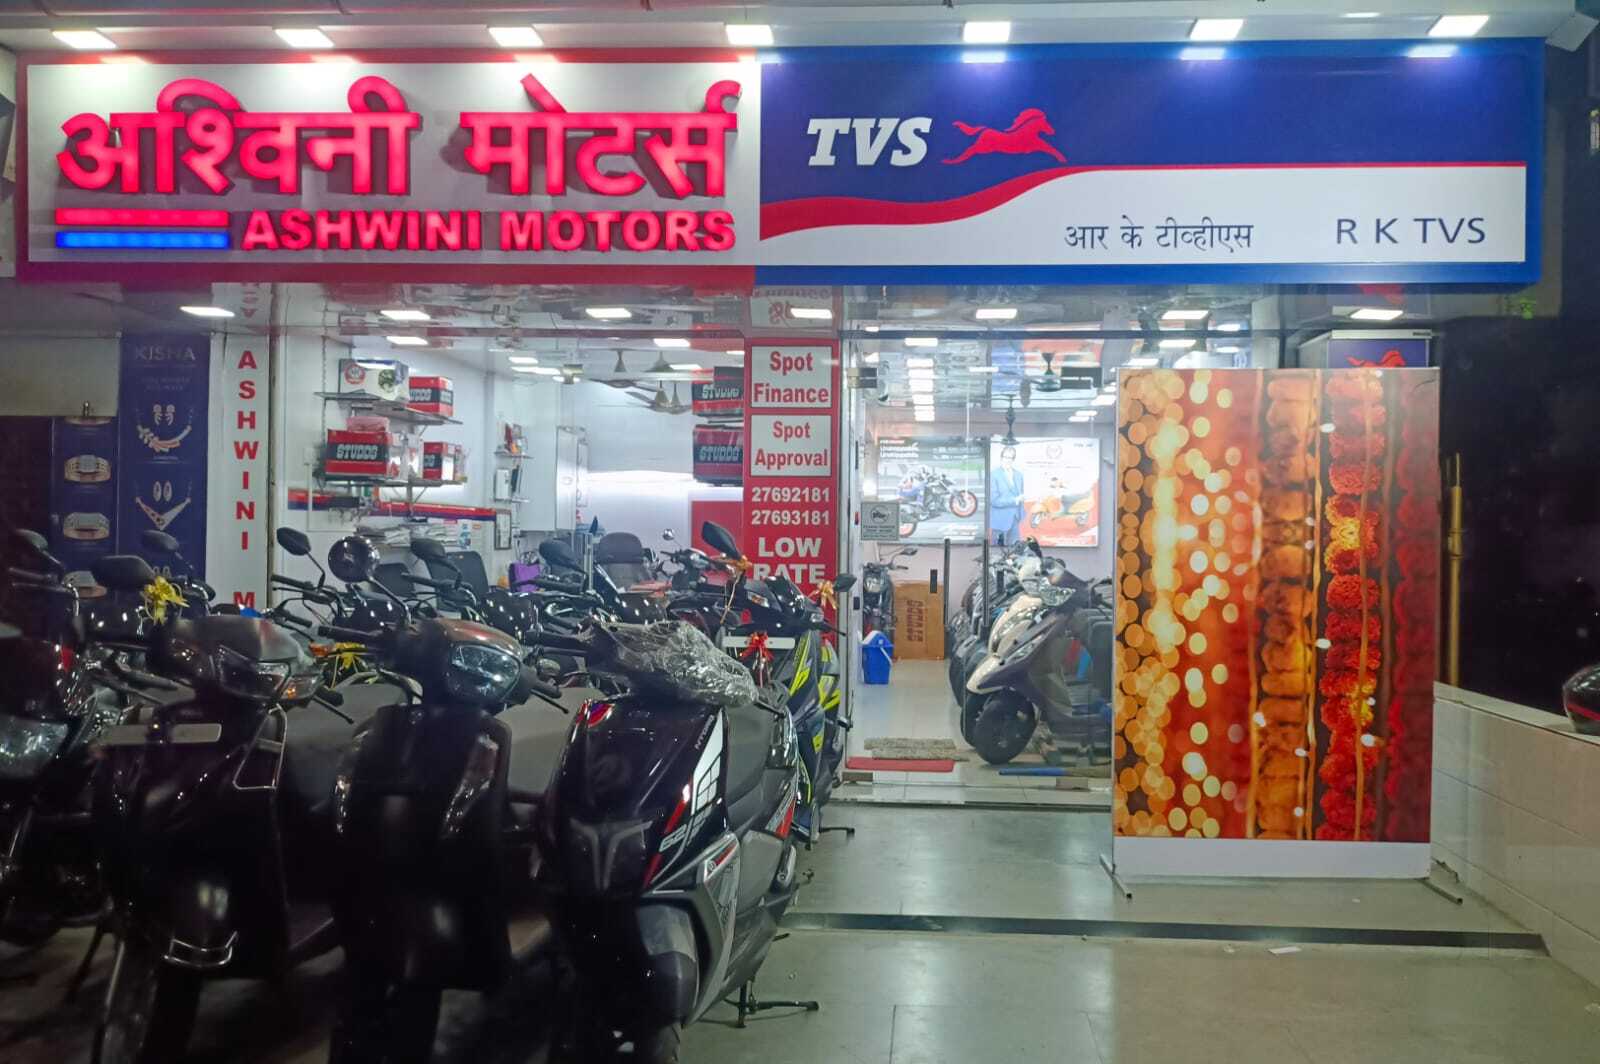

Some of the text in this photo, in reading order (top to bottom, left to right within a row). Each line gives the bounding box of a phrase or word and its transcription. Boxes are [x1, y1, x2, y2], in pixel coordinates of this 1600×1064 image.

[807, 117, 932, 167] TVS
[241, 210, 736, 251] ASHWINI MOTORS
[1064, 226, 1108, 249] आर
[1119, 215, 1144, 249] के
[1337, 218, 1485, 244] R K TVS
[769, 351, 813, 376] Spot
[753, 383, 829, 403] Finance
[773, 421, 811, 442] Spot
[234, 350, 259, 550] ASHWINI
[755, 449, 828, 470] Approval
[751, 487, 830, 502] 27692181
[751, 510, 830, 525] 27693181
[758, 537, 822, 558] LOW
[753, 563, 826, 584] RATE
